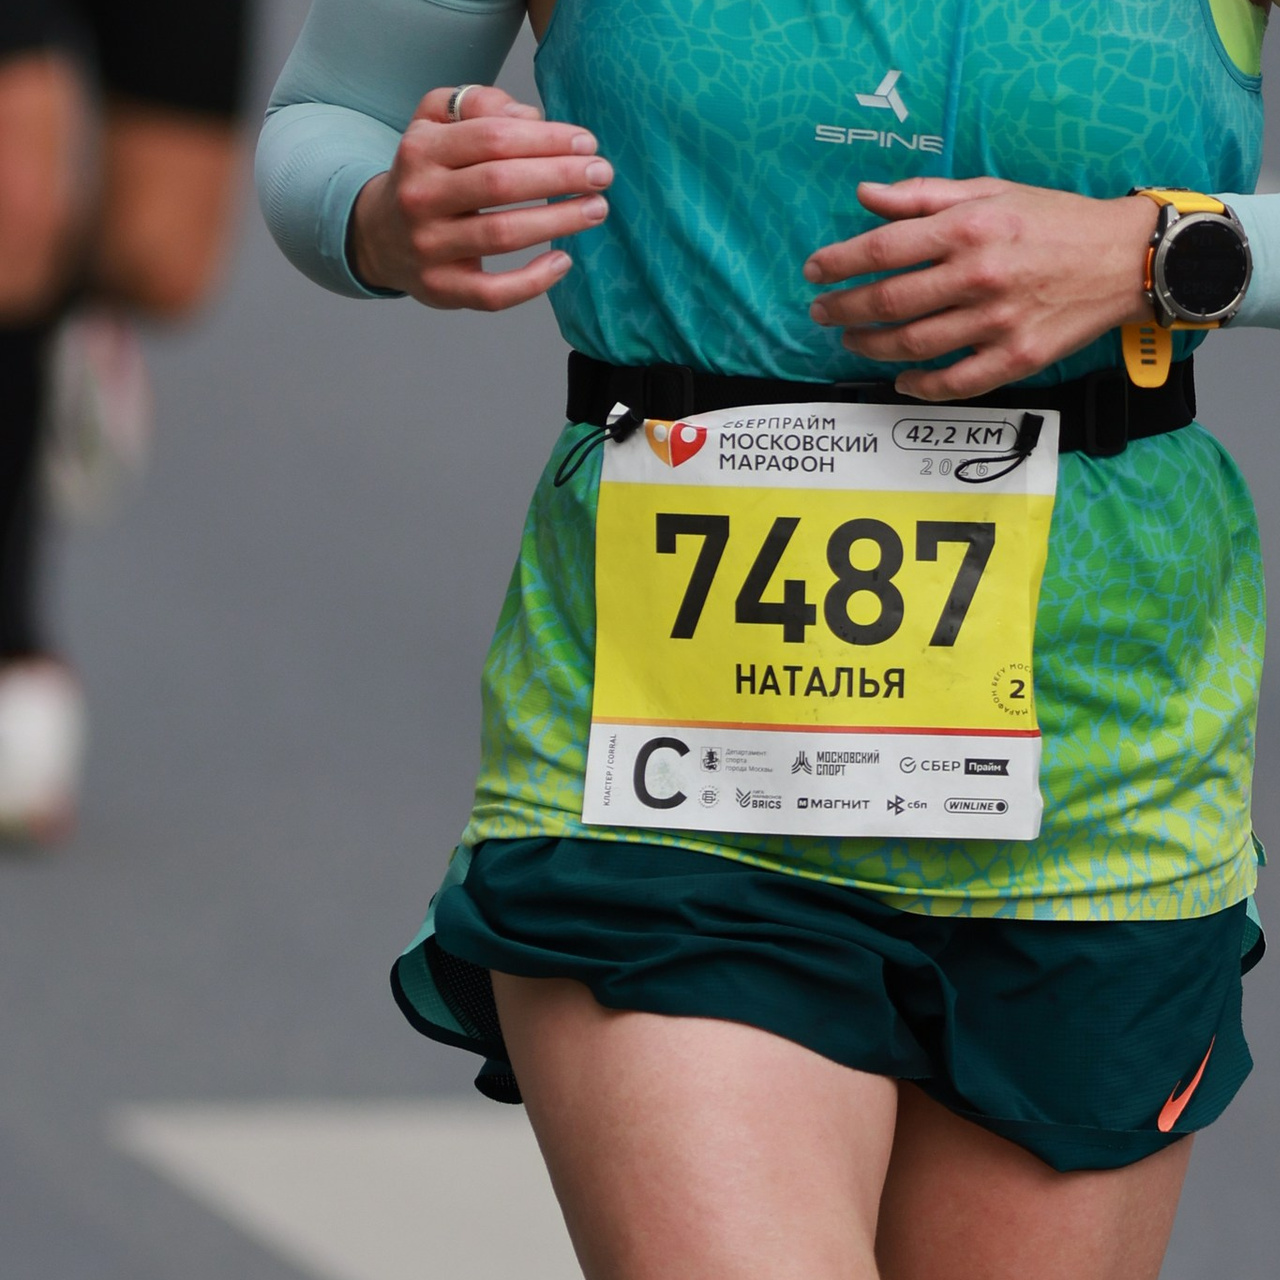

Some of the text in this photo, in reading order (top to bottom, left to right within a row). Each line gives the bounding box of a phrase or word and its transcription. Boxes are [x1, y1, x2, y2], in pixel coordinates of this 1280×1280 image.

[814, 123, 944, 155] SPINE
[722, 414, 836, 431] СБЕРПРАЙМ
[719, 432, 878, 453] МОСКОВСКИЙ
[906, 425, 957, 446] 42,2
[719, 453, 835, 473] МАРАФОН
[655, 512, 997, 648] 7487
[735, 663, 906, 699] НАТАЛЬЯ
[1009, 678, 1026, 699] 2
[607, 734, 617, 765] CORRAL
[725, 748, 767, 757] Департамент
[816, 749, 880, 764] МОСКОВСКИЙ
[748, 765, 774, 773] Москвы
[816, 764, 846, 776] СПОРТ
[921, 760, 961, 772] СБЕР
[968, 762, 1002, 773] Прайм
[603, 770, 613, 807] КЛАСТЕР
[751, 799, 782, 810] BRICS
[949, 800, 994, 811] WINLINE
